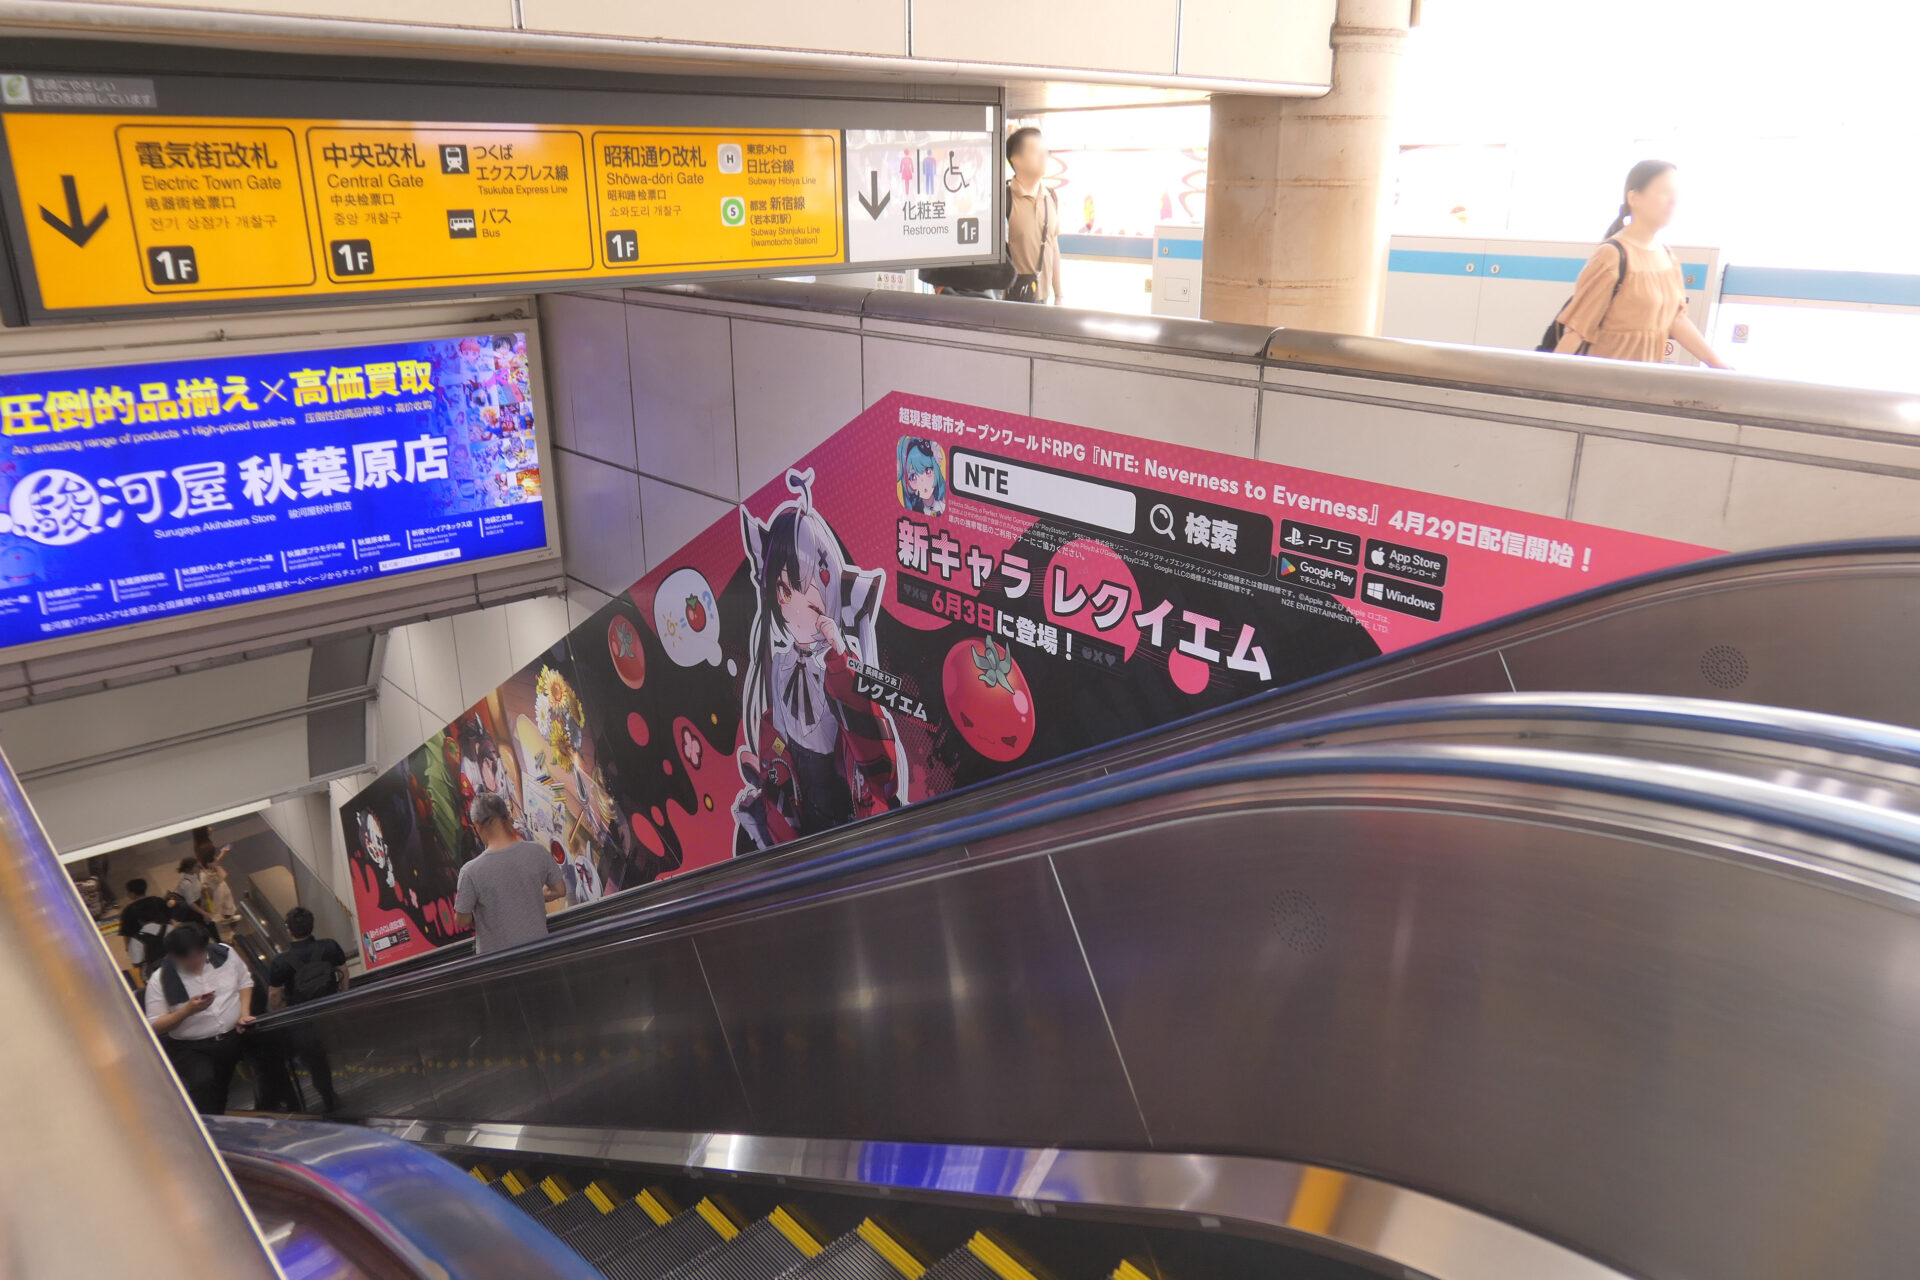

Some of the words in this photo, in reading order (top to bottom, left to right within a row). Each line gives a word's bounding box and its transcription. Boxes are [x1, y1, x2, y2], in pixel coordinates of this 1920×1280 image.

[135, 141, 278, 170] 電気街改札
[322, 143, 426, 169] 中央改札
[473, 144, 513, 160] つくば
[604, 145, 707, 168] 昭和通り改札
[726, 153, 734, 164] H
[747, 144, 787, 155] 東京メトロ
[476, 165, 569, 182] エクスプレス線
[746, 159, 794, 175] 日比谷線
[141, 175, 199, 191] Electric
[202, 175, 242, 190] Town
[247, 175, 282, 190] Gate
[327, 173, 384, 189] Central
[389, 174, 424, 188] Gate
[606, 172, 674, 185] Shōwa-dōri
[677, 173, 704, 185] Gate
[748, 177, 777, 186] Subway
[778, 176, 800, 186] Hibiya
[802, 176, 816, 185] Line
[478, 185, 514, 195] Tsukuba
[516, 185, 549, 197] Express
[551, 185, 568, 194] Line
[730, 206, 737, 217] S
[750, 200, 767, 211] 都営
[770, 196, 806, 211] 新宿線
[903, 201, 946, 220] 化粧室
[481, 208, 512, 225] バス
[482, 228, 501, 238] Bus
[750, 227, 777, 238] Subway
[779, 226, 805, 237] Shinjuku
[807, 226, 821, 235] Line
[903, 225, 949, 236] Restrooms
[961, 221, 977, 241] 1F
[611, 234, 635, 258] 1F
[751, 237, 792, 248] (Iwamotocho
[794, 236, 818, 247] Station)
[156, 251, 193, 280] 1F
[338, 244, 369, 272] 1F
[12, 445, 30, 455] An
[32, 440, 82, 452] amazing
[84, 437, 117, 448] range
[119, 433, 131, 444] of
[133, 429, 180, 444] products
[192, 421, 250, 437] High-priced
[253, 416, 296, 430] trade-ins
[237, 435, 449, 506] 秋葉原店
[964, 461, 1009, 496] NTE
[898, 407, 1086, 462] 超現実都市オープンワールドRPG
[1144, 458, 1239, 495] Neverness
[1244, 480, 1267, 501] to
[1273, 485, 1379, 526] Everness』
[1388, 510, 1592, 572] 4月29日配信開始！
[154, 524, 201, 540] Surugaya
[203, 518, 250, 532] Akihabara
[251, 513, 276, 524] Store
[1185, 512, 1239, 555] 検索
[1308, 534, 1353, 556] PS5
[1389, 549, 1411, 567] App
[1412, 553, 1441, 570] Store
[1300, 561, 1334, 583] Google
[1334, 568, 1354, 587] Play
[1388, 562, 1437, 579] からダウンロード
[1300, 575, 1336, 590] で手に入れよう
[897, 519, 1032, 599] 新キャラ
[1053, 568, 1272, 682] レクイエム
[1386, 588, 1436, 612] Windows
[1296, 601, 1354, 624] ENTERTAINMENT
[932, 590, 1072, 661] 6月3日に登場！
[848, 661, 862, 671] CV:
[857, 677, 928, 721] レクイエム
